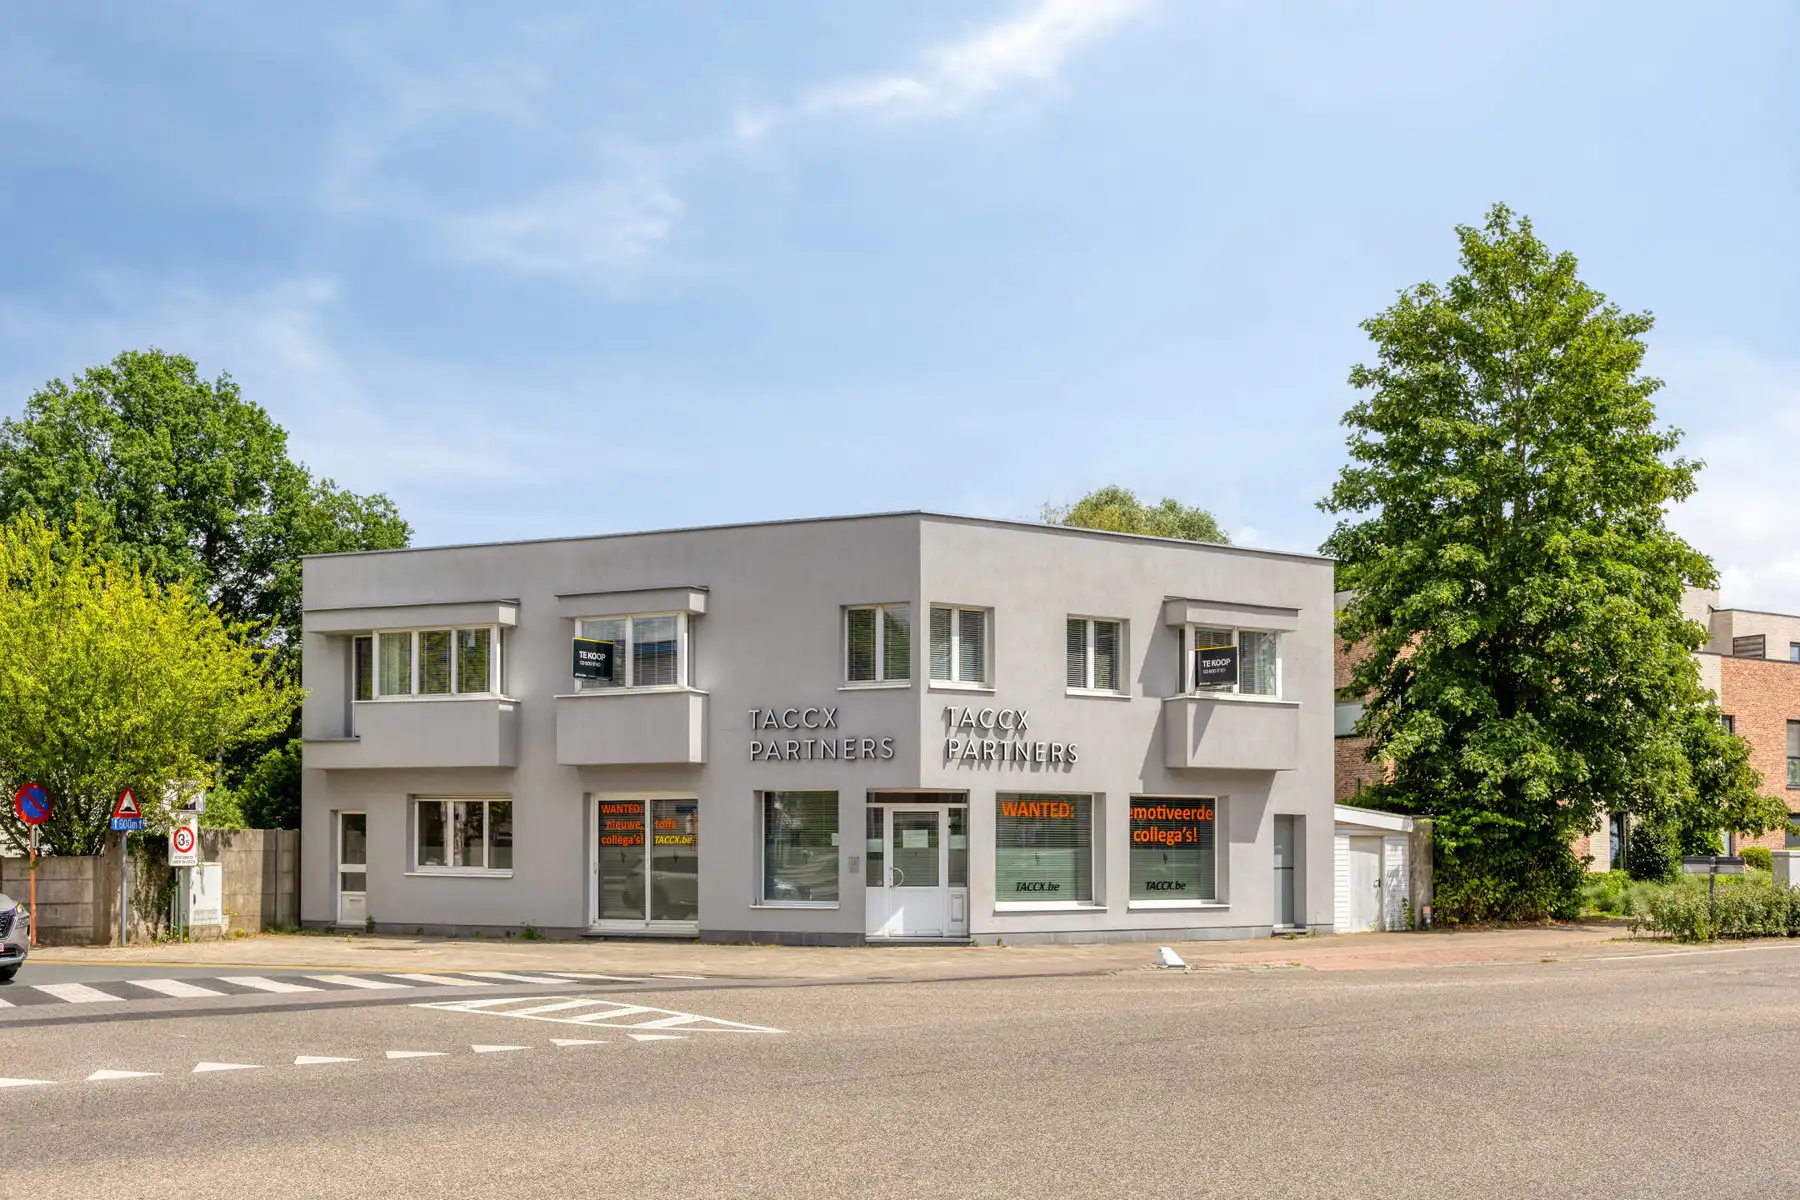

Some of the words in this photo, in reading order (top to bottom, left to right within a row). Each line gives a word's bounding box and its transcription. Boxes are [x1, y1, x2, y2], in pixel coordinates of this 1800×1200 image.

[578, 650, 588, 659] TE
[587, 651, 606, 661] KOOP
[1202, 660, 1211, 668] TE
[1211, 658, 1231, 667] KOOP
[748, 707, 838, 730] TACCX
[946, 706, 1030, 730] TACCX
[750, 737, 895, 761] PARTNERS
[947, 738, 1079, 763] PARTNERS
[1001, 800, 1075, 818] WANTED:
[655, 835, 693, 845] TACCX.be
[1133, 826, 1198, 846] collega's!
[1015, 881, 1060, 892] TACCX.be
[1145, 880, 1187, 891] TACCX.be
